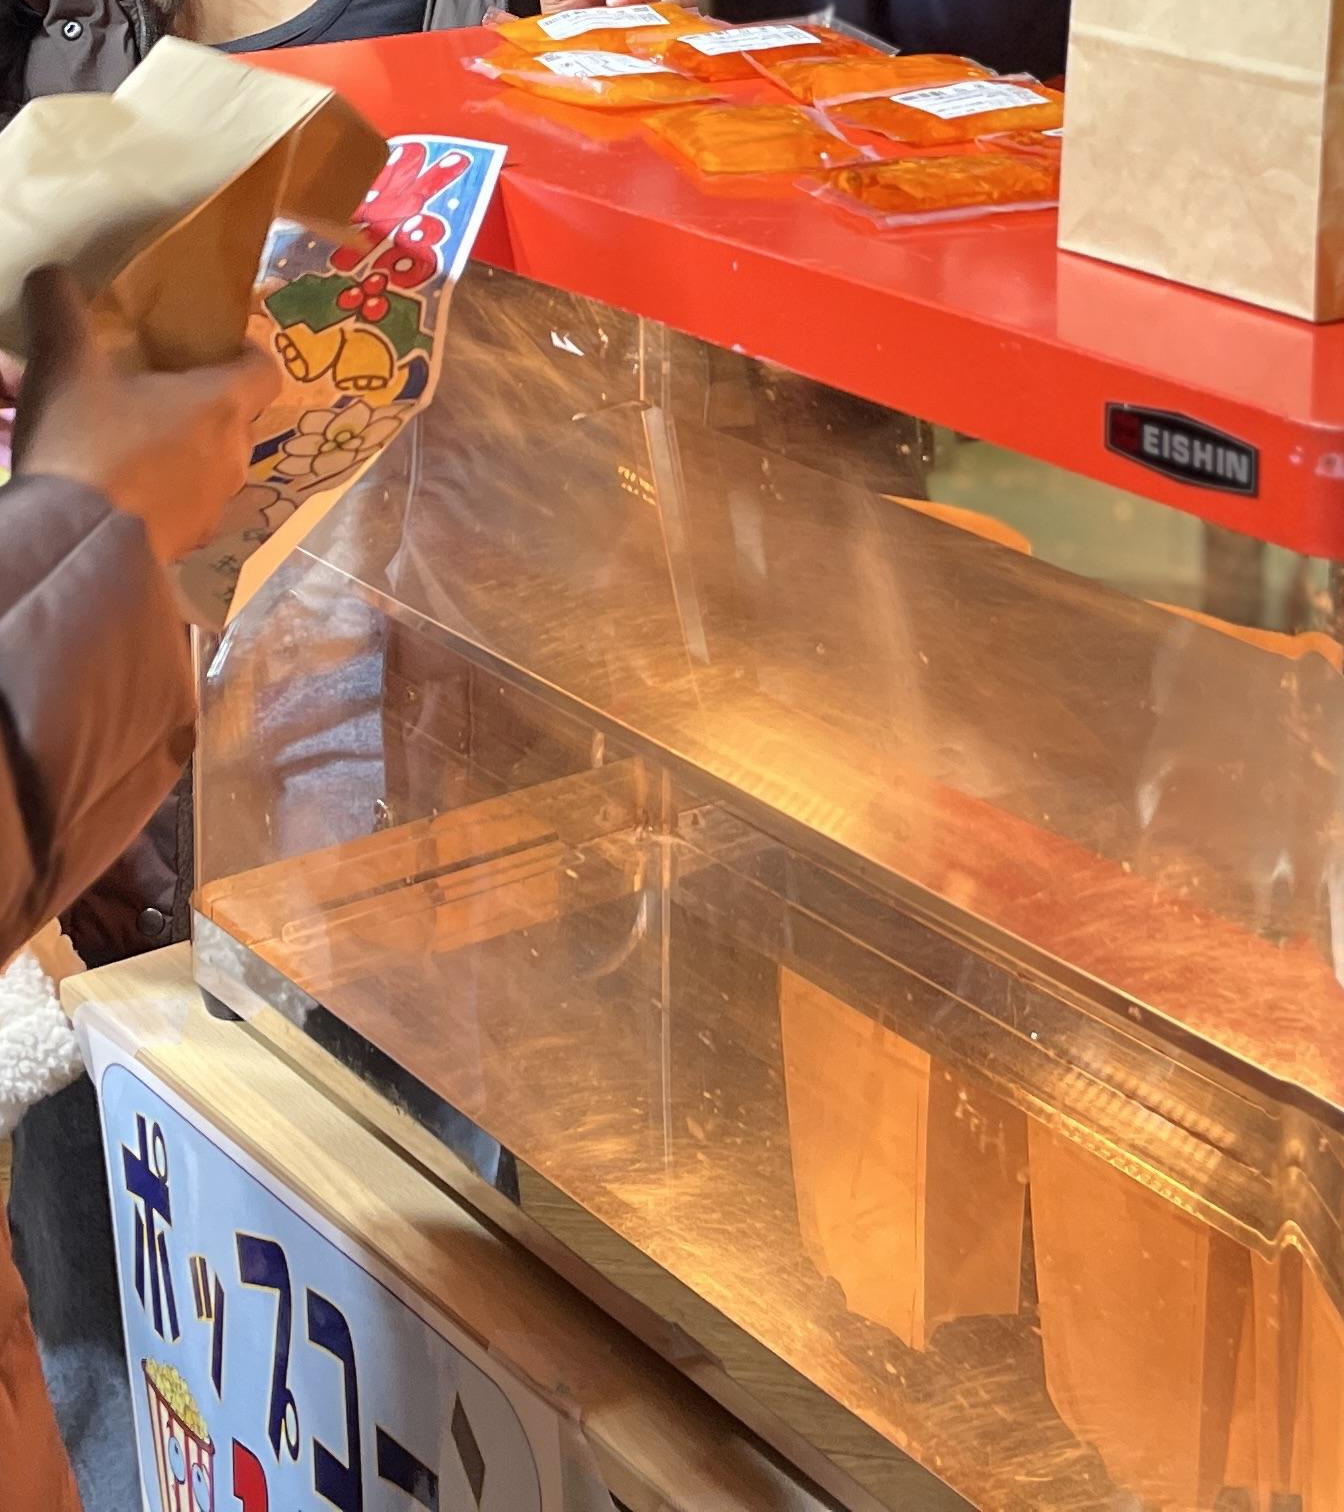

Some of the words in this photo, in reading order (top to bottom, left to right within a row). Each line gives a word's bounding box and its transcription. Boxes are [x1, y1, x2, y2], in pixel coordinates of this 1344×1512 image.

[1142, 423, 1250, 484] EISHIN
[120, 1110, 486, 1512] ポップコー
